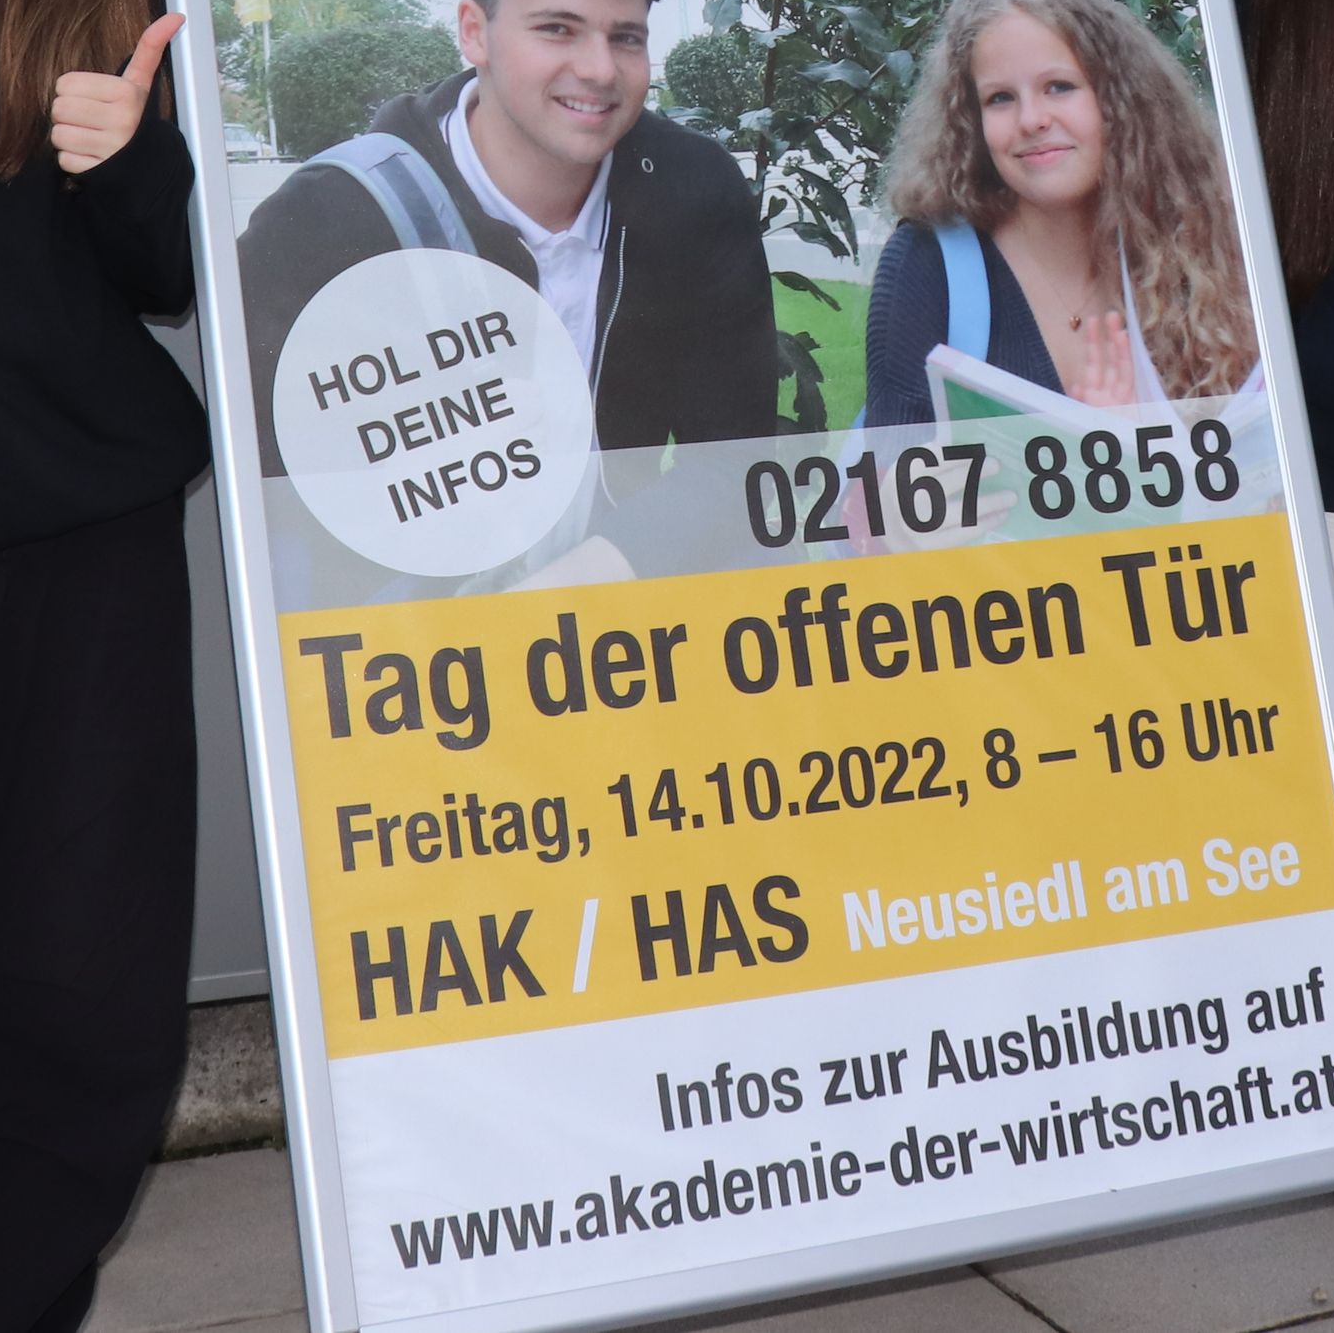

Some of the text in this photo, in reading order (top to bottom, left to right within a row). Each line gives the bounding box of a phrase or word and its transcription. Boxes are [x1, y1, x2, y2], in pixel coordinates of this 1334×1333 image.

[309, 312, 516, 410] HOL DIR
[358, 379, 513, 462] DEINE
[388, 439, 540, 522] INFOS
[746, 419, 1239, 547] 02167 8858
[301, 544, 1255, 750] Tag der offenen Tür
[337, 794, 589, 871] Freitag,
[608, 737, 968, 836] 14.10.2022,
[984, 729, 1020, 788] 8
[1094, 710, 1164, 772] 16
[1181, 698, 1278, 761] Uhr
[351, 910, 545, 1019] HAK
[632, 876, 808, 981] HAS
[843, 865, 1087, 951] Neusiedl
[1104, 858, 1189, 912] am
[1203, 842, 1300, 896] See
[657, 967, 1324, 1130] Infos zur Ausbildung auf
